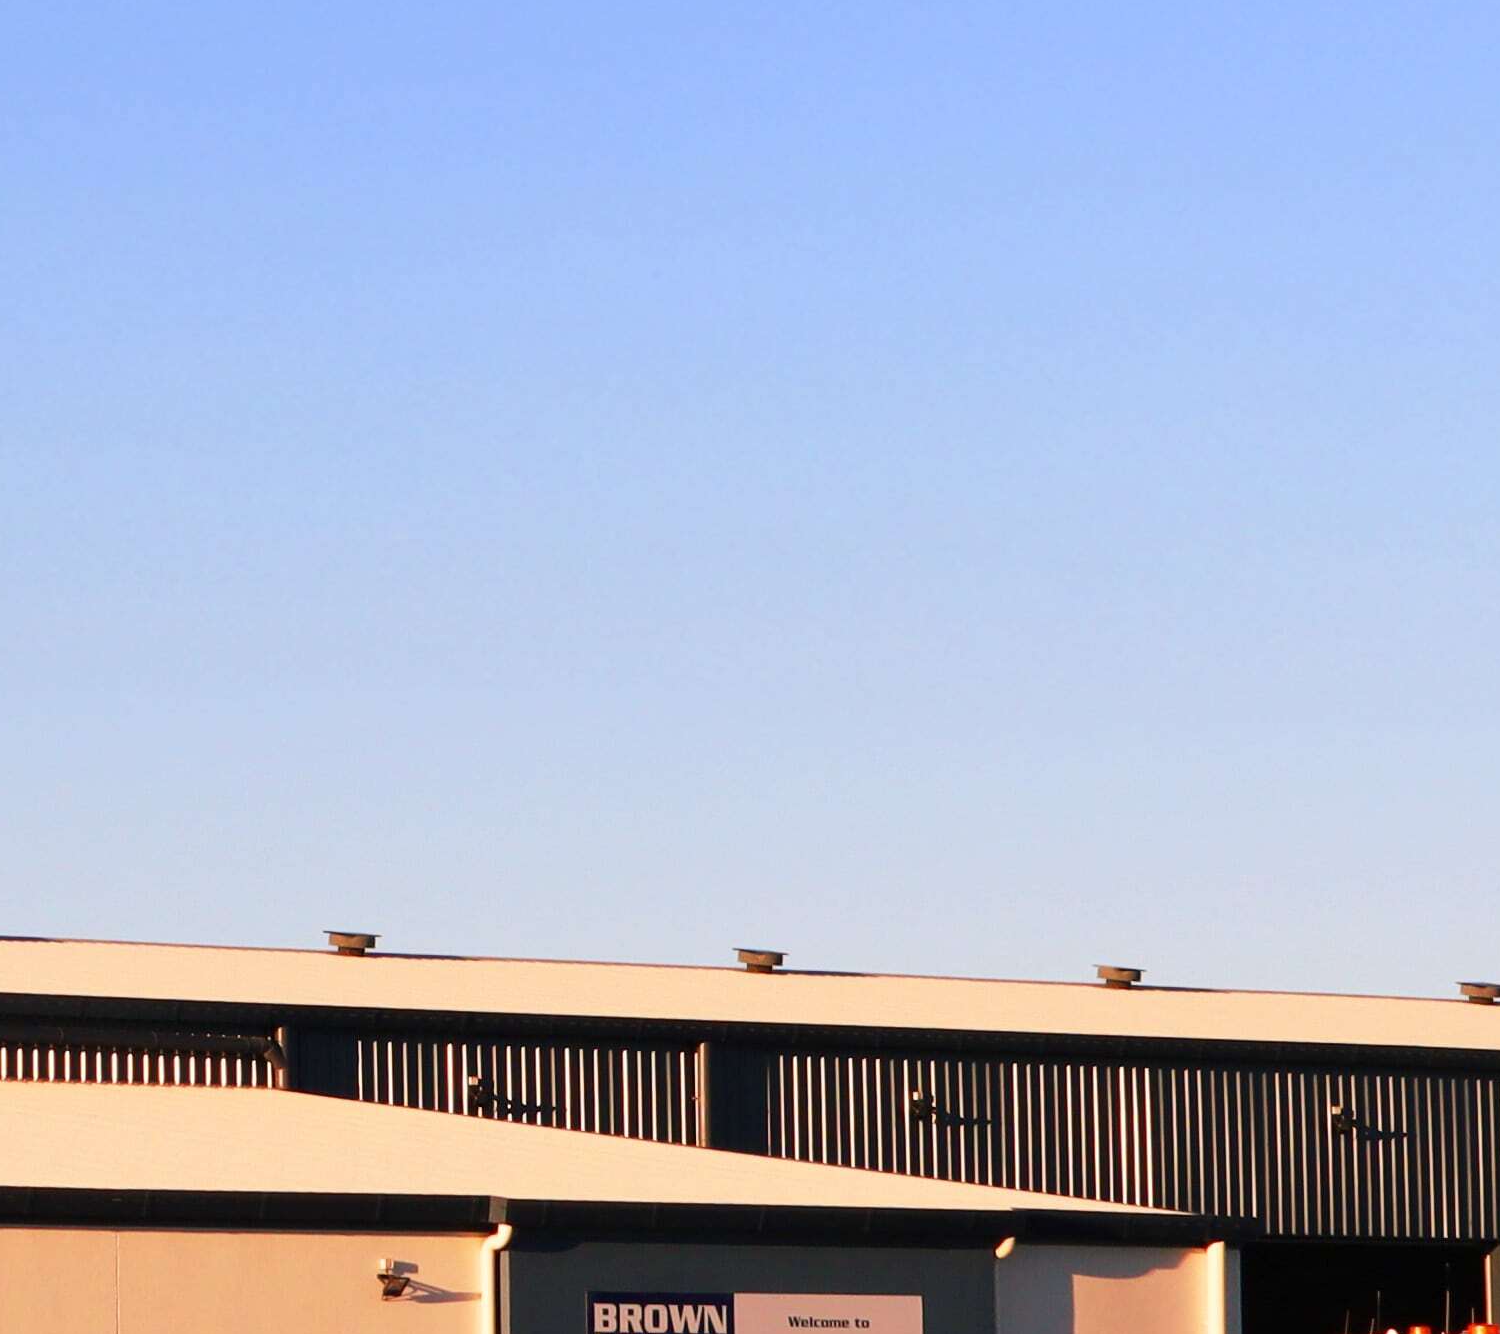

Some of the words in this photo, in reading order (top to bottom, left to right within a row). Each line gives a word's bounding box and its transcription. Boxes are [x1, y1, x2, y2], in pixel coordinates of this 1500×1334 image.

[593, 1302, 728, 1334] BROWN
[787, 1315, 850, 1329] Welcome
[854, 1317, 870, 1329] to
